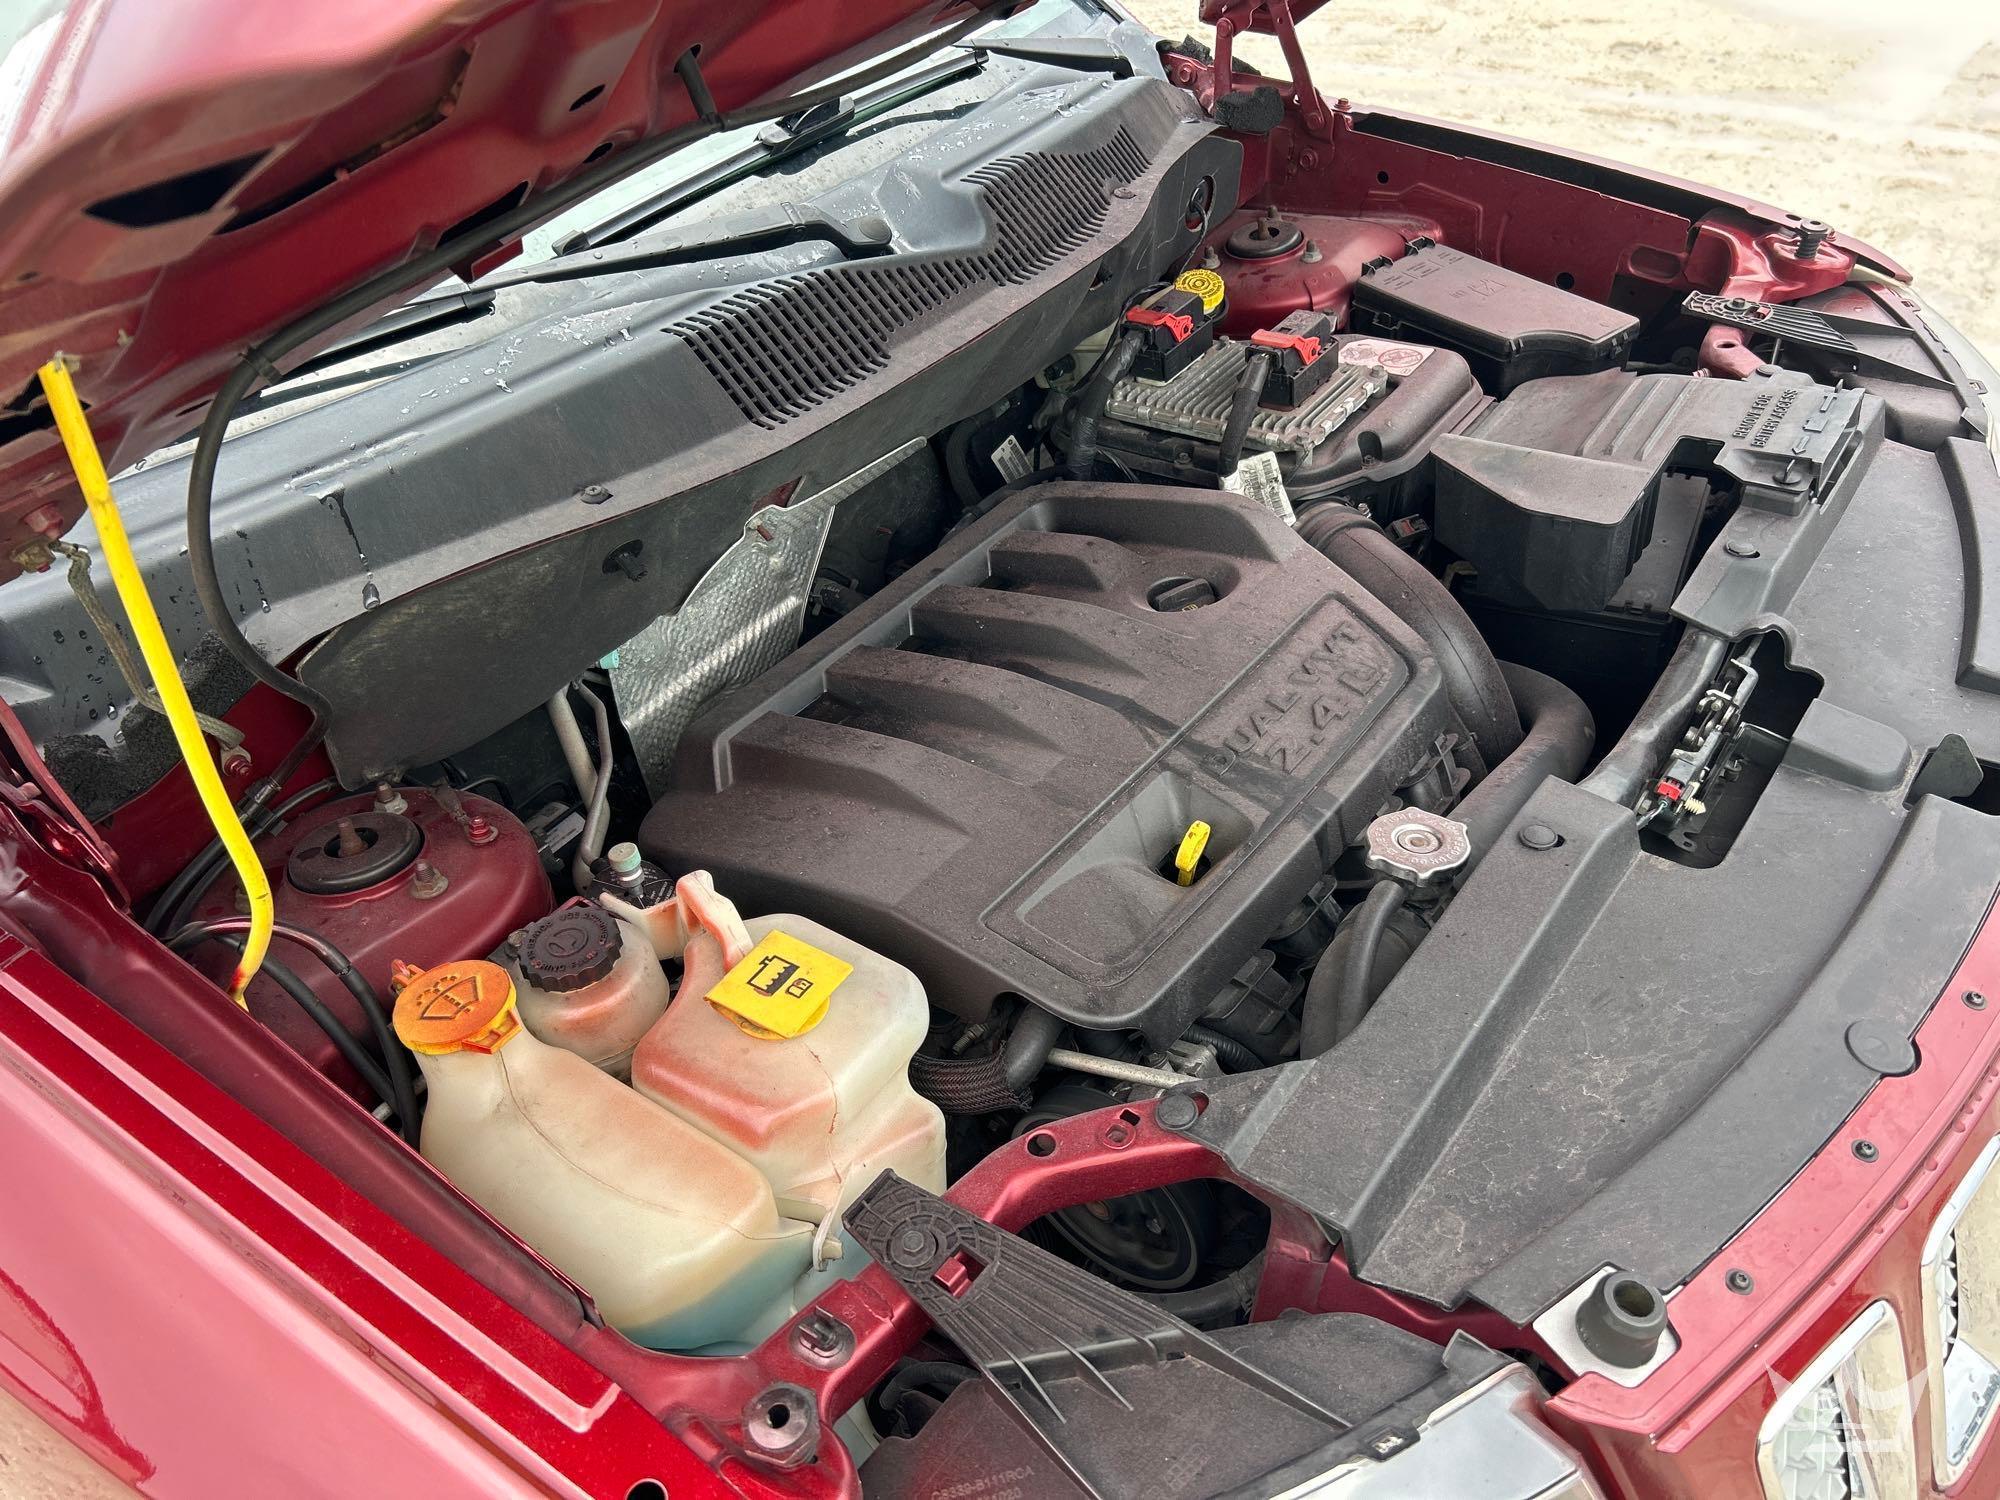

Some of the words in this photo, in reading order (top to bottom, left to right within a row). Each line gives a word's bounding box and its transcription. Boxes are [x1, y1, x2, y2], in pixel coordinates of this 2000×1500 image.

[1732, 411, 1762, 439] REMOVE
[1752, 394, 1773, 410] FOR
[1751, 418, 1780, 448] BATTERY
[1771, 388, 1799, 419] ACCESS
[1207, 692, 1302, 775] DUAL
[1286, 620, 1356, 683] VVT
